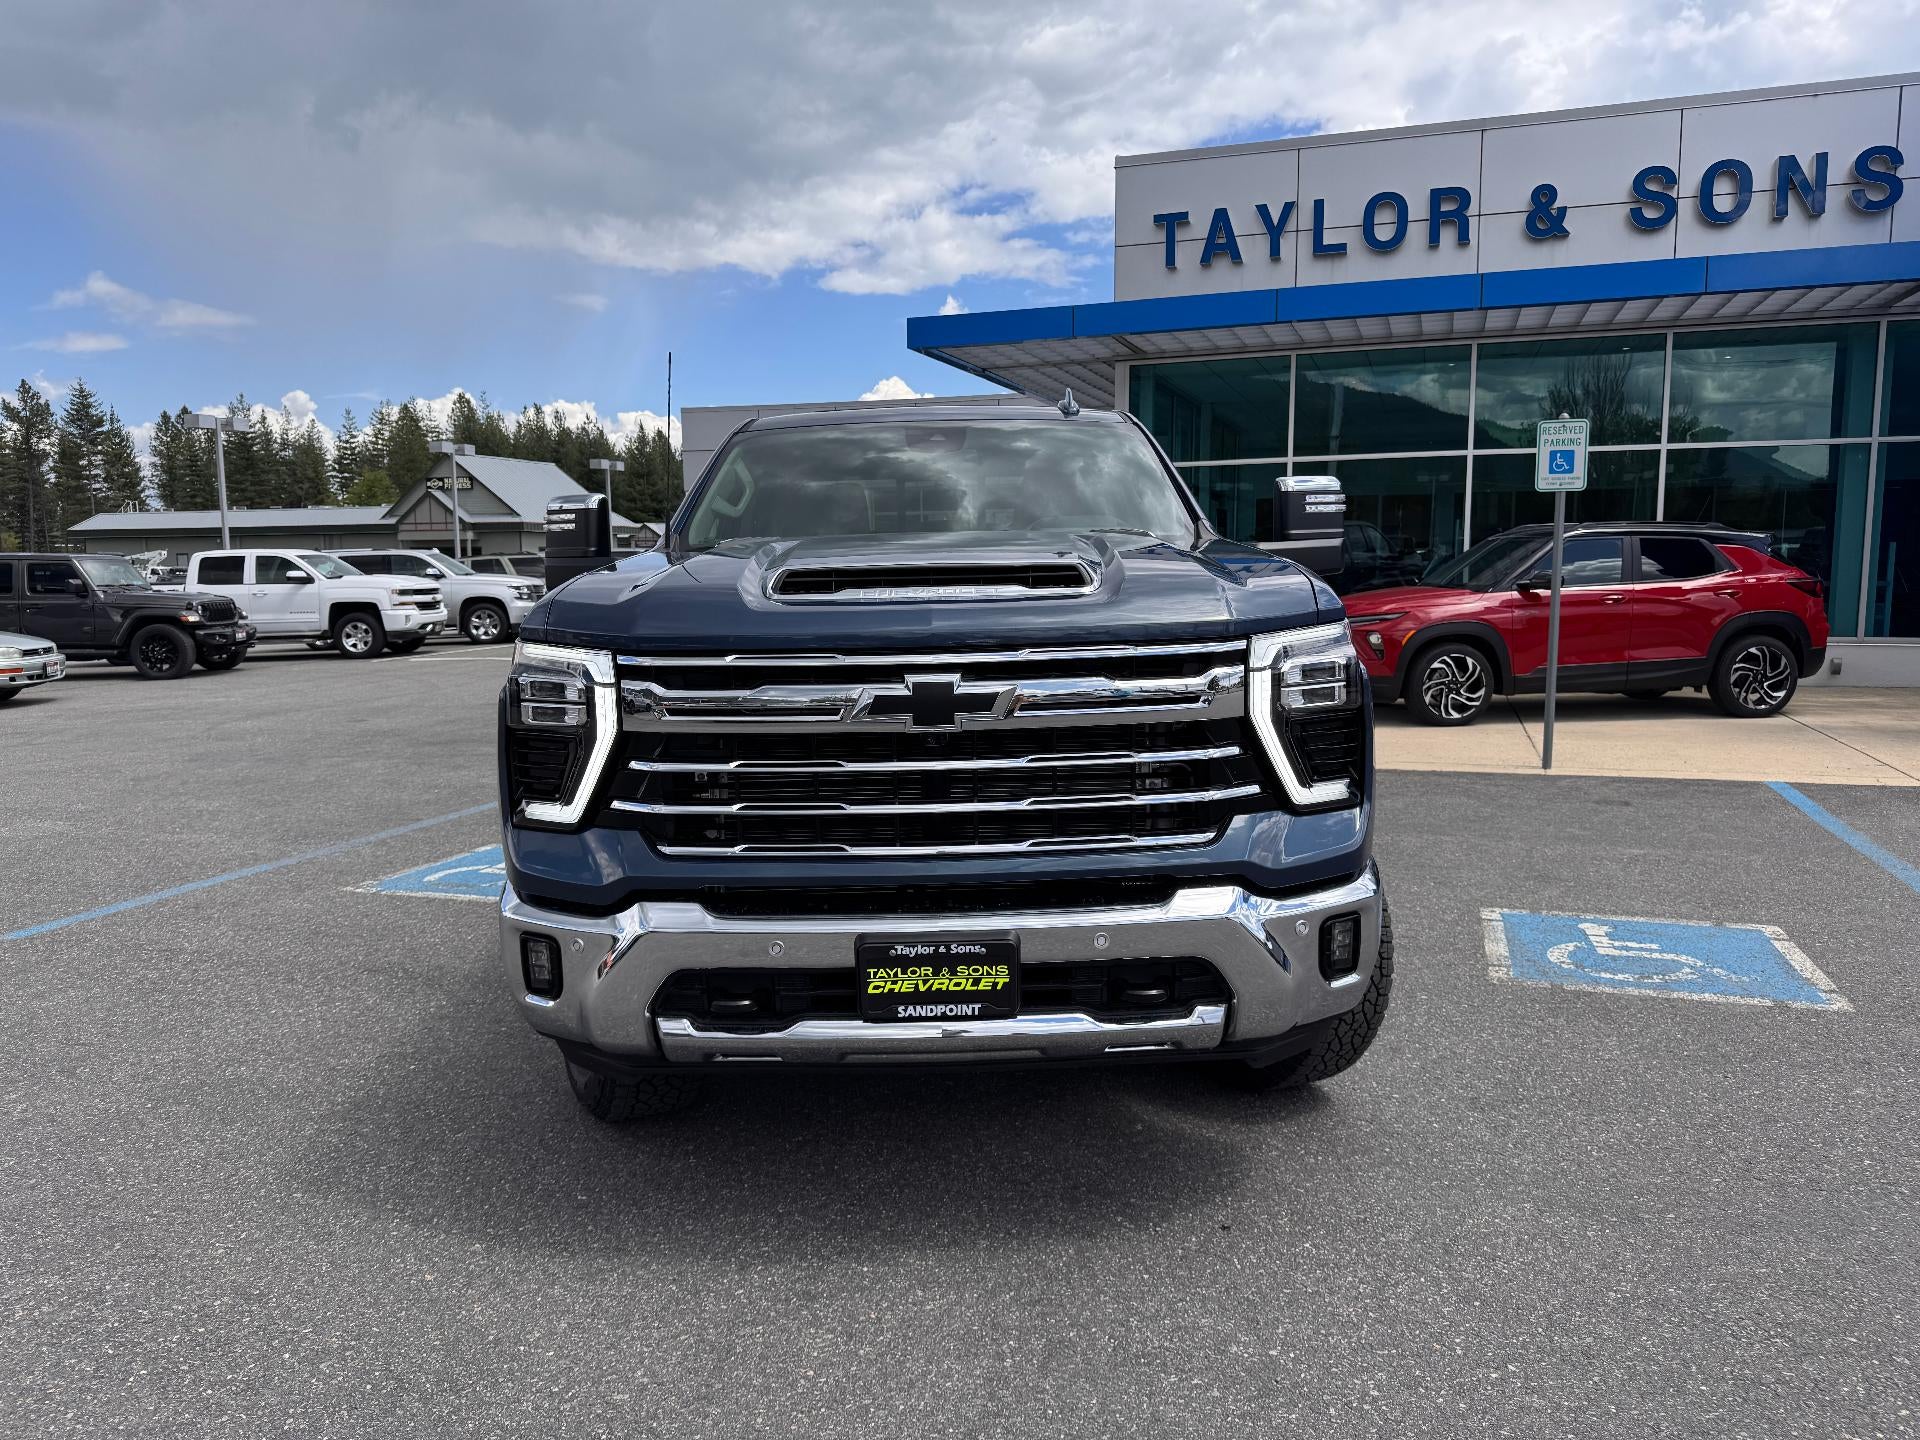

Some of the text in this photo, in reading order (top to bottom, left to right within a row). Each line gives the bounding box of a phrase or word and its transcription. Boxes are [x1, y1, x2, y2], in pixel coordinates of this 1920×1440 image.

[1152, 145, 1906, 269] TAYLOR & SONS
[1542, 426, 1584, 435] RESERVED
[1543, 438, 1581, 447] PARKING
[444, 477, 471, 485] NAURAL
[895, 945, 935, 957] Taylor
[950, 944, 981, 953] Sons
[867, 965, 1008, 979] TAYLOR & SONS
[867, 978, 1009, 993] CHEVROLET
[897, 1004, 981, 1017] SANDPOINT
